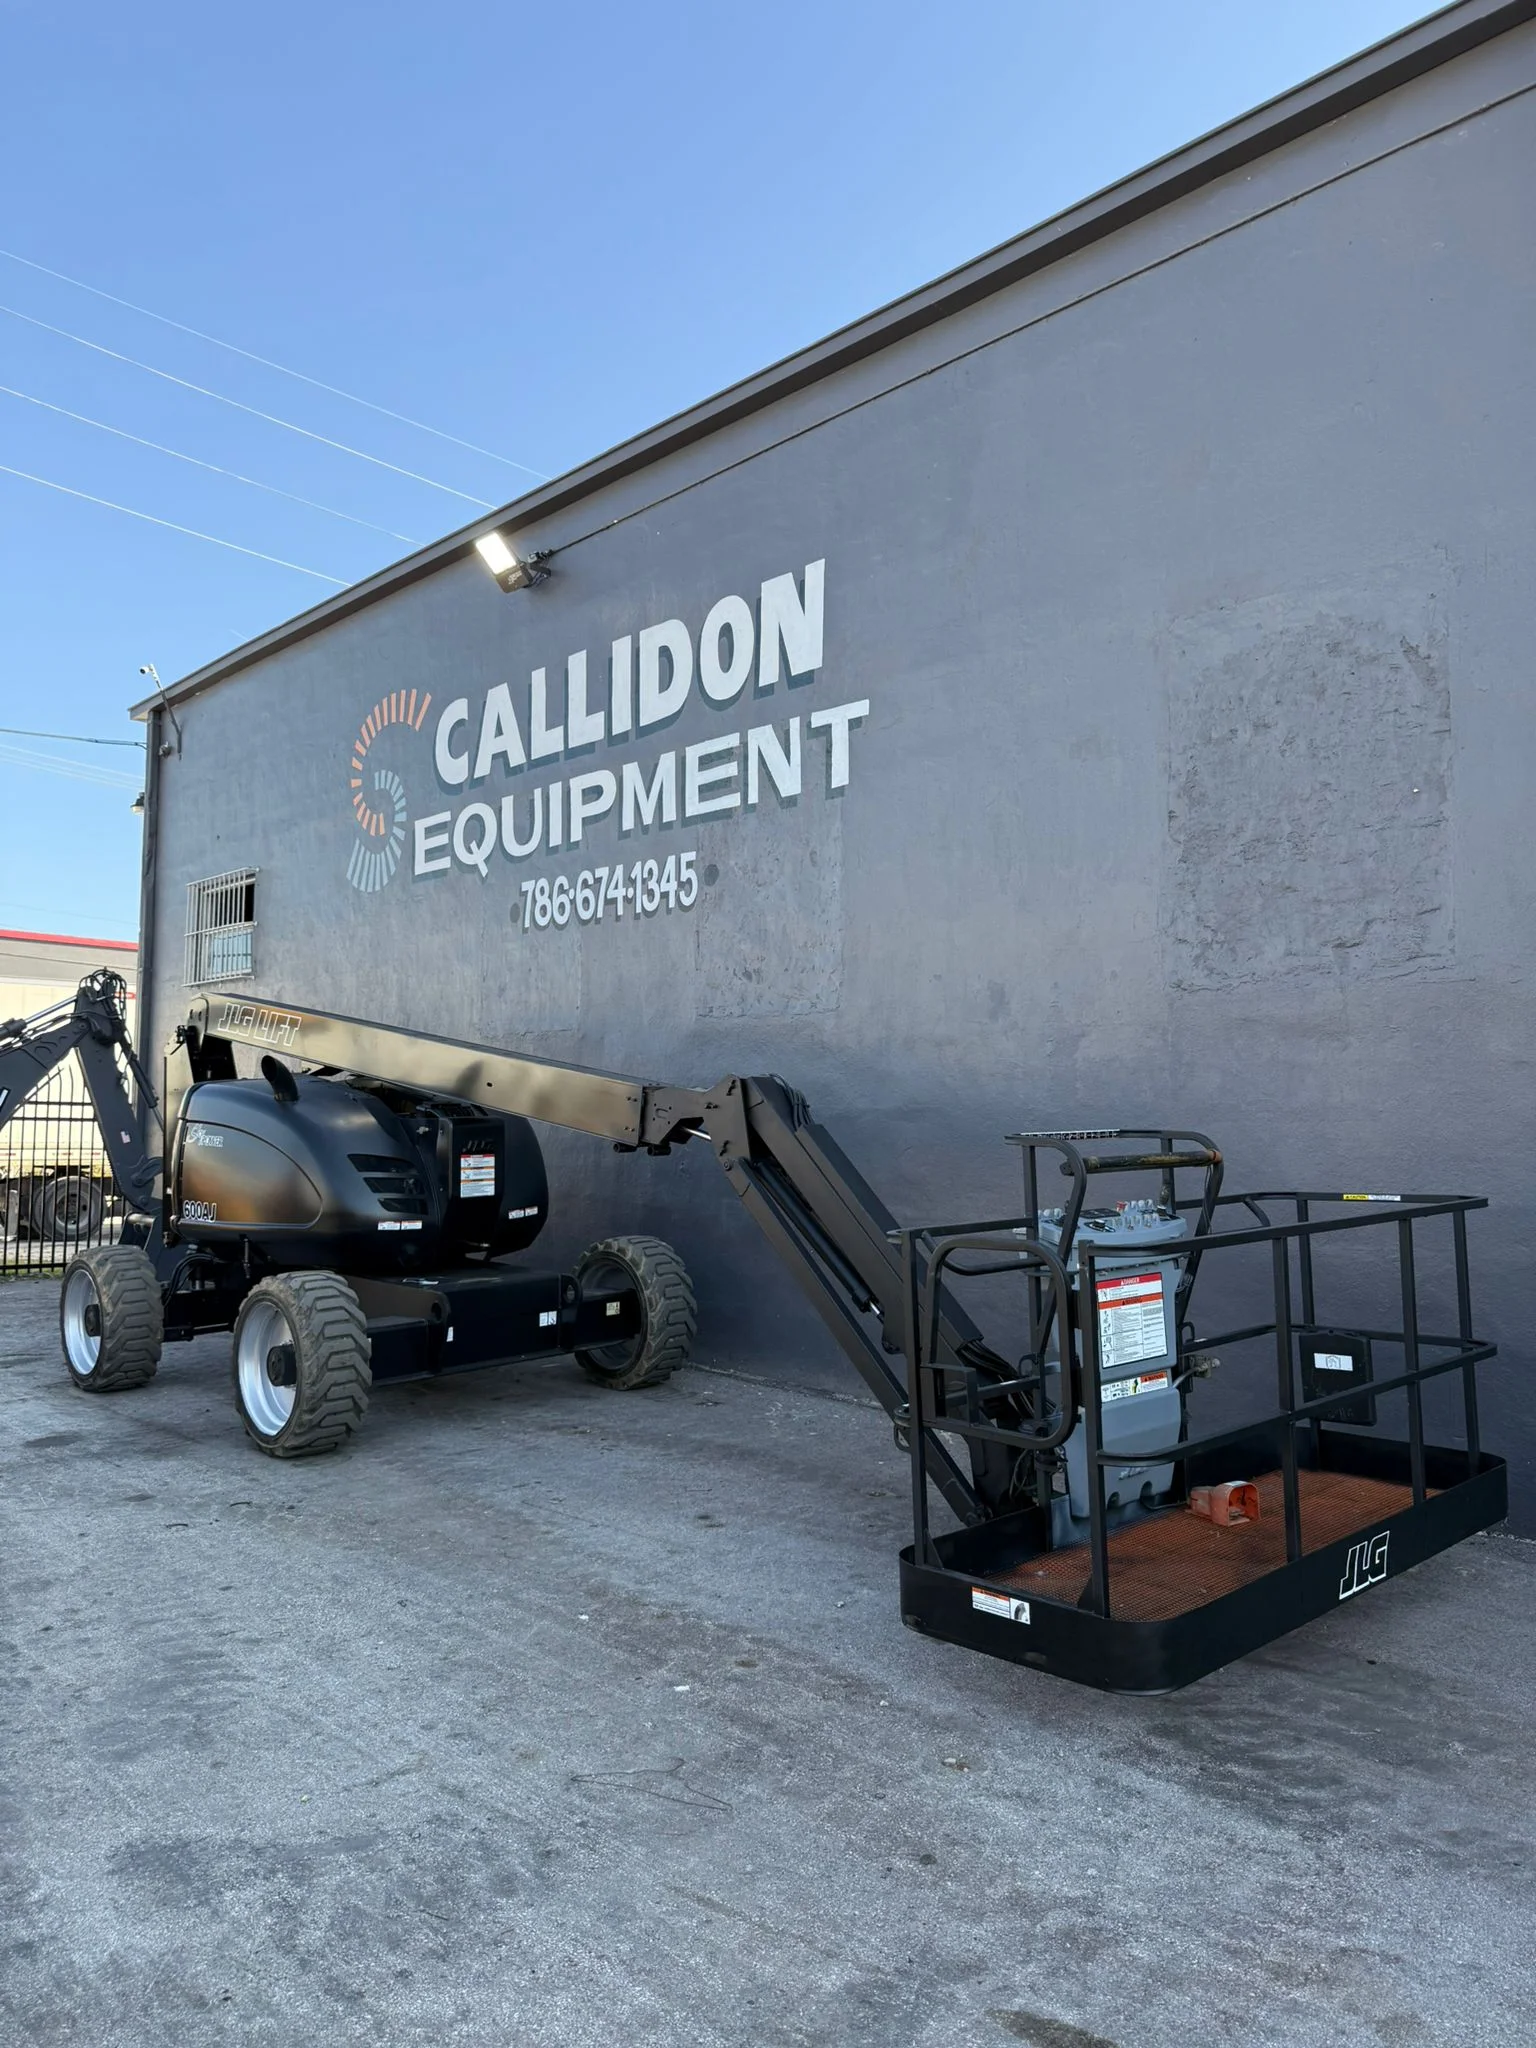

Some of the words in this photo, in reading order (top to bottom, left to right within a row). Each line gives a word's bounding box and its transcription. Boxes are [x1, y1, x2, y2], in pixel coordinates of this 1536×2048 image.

[434, 557, 826, 785] CALLIDON
[414, 698, 870, 878] EQUIPMENT
[217, 1002, 256, 1037] JLG
[253, 1009, 302, 1047] LIFT
[183, 1200, 217, 1222] 600AJ
[1339, 1530, 1390, 1600] JLG
